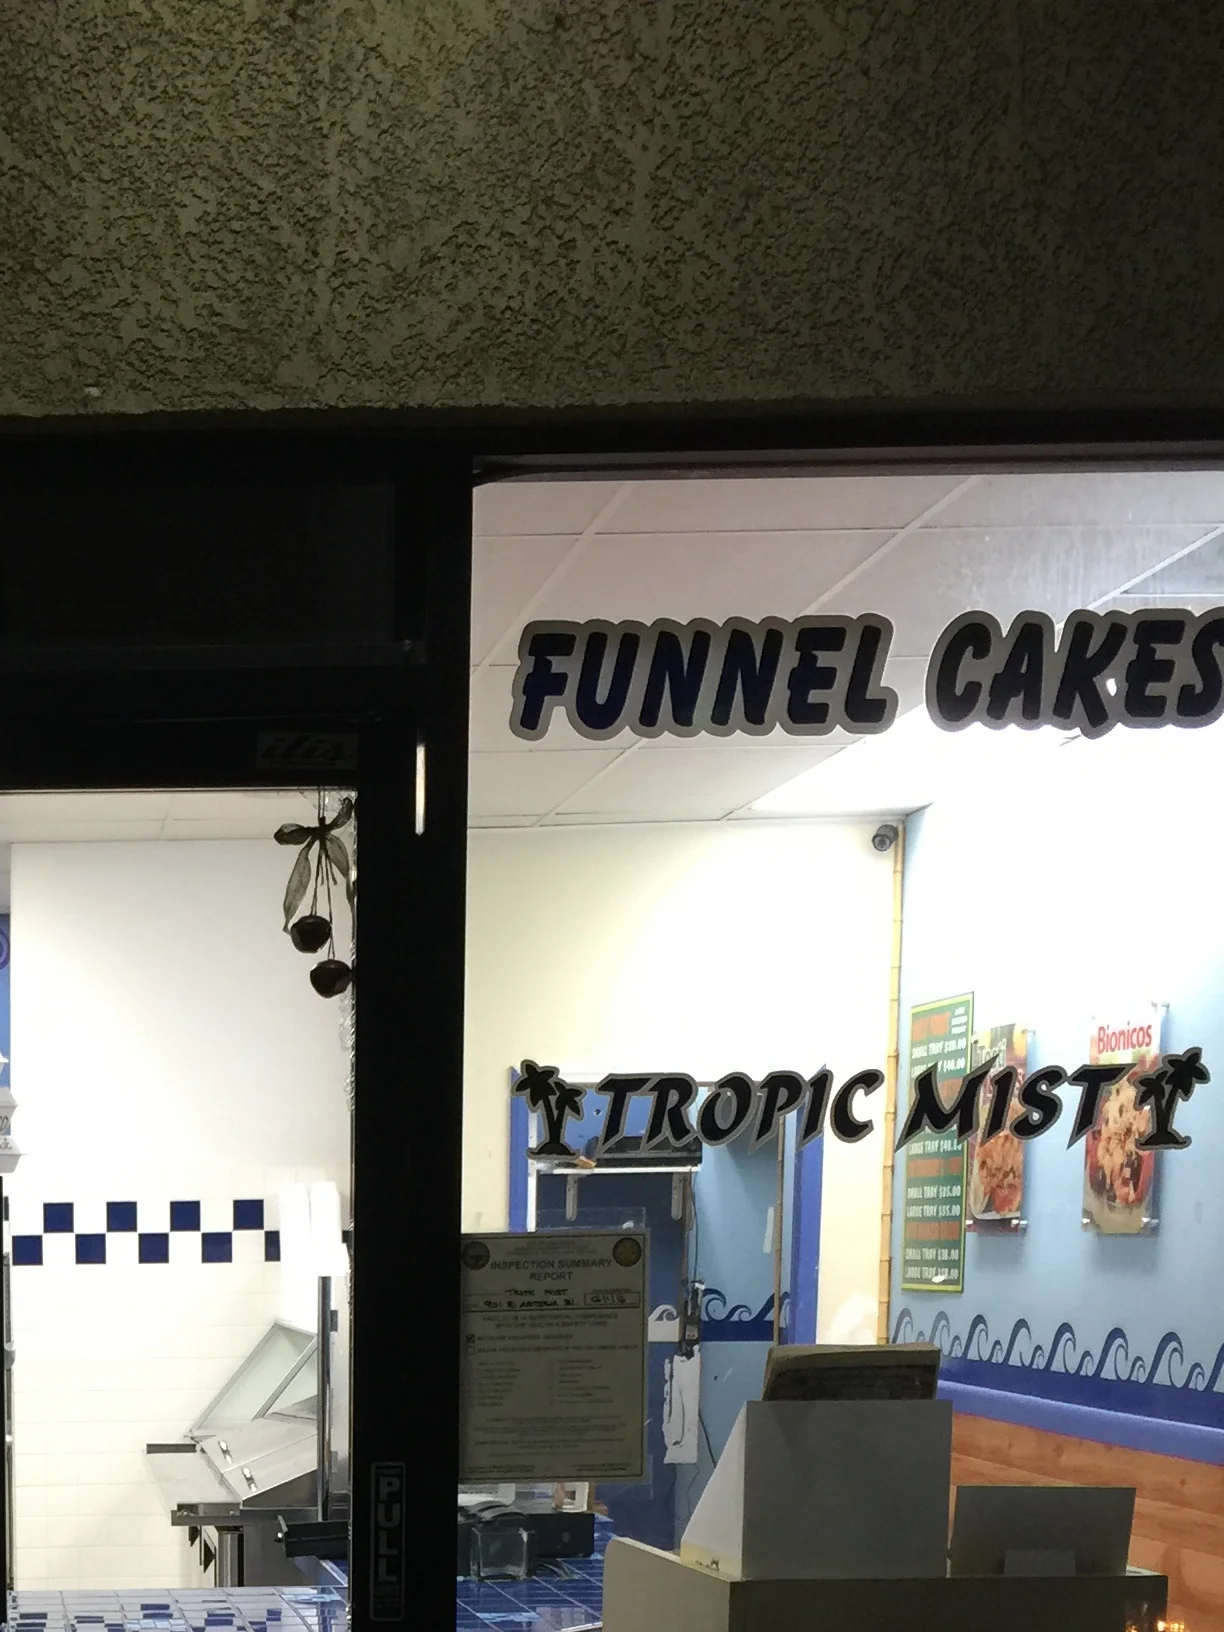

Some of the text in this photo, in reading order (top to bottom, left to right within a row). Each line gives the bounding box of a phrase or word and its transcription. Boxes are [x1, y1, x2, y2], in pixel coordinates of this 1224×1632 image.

[516, 615, 1224, 736] FUNNEL CAKES
[1097, 1021, 1153, 1055] Bionicos
[595, 1055, 1140, 1153] TROPIC MIST
[490, 1258, 613, 1270] INSPECTION SUMMARY
[529, 1272, 573, 1281] REPORT
[377, 1475, 401, 1582] PULL
